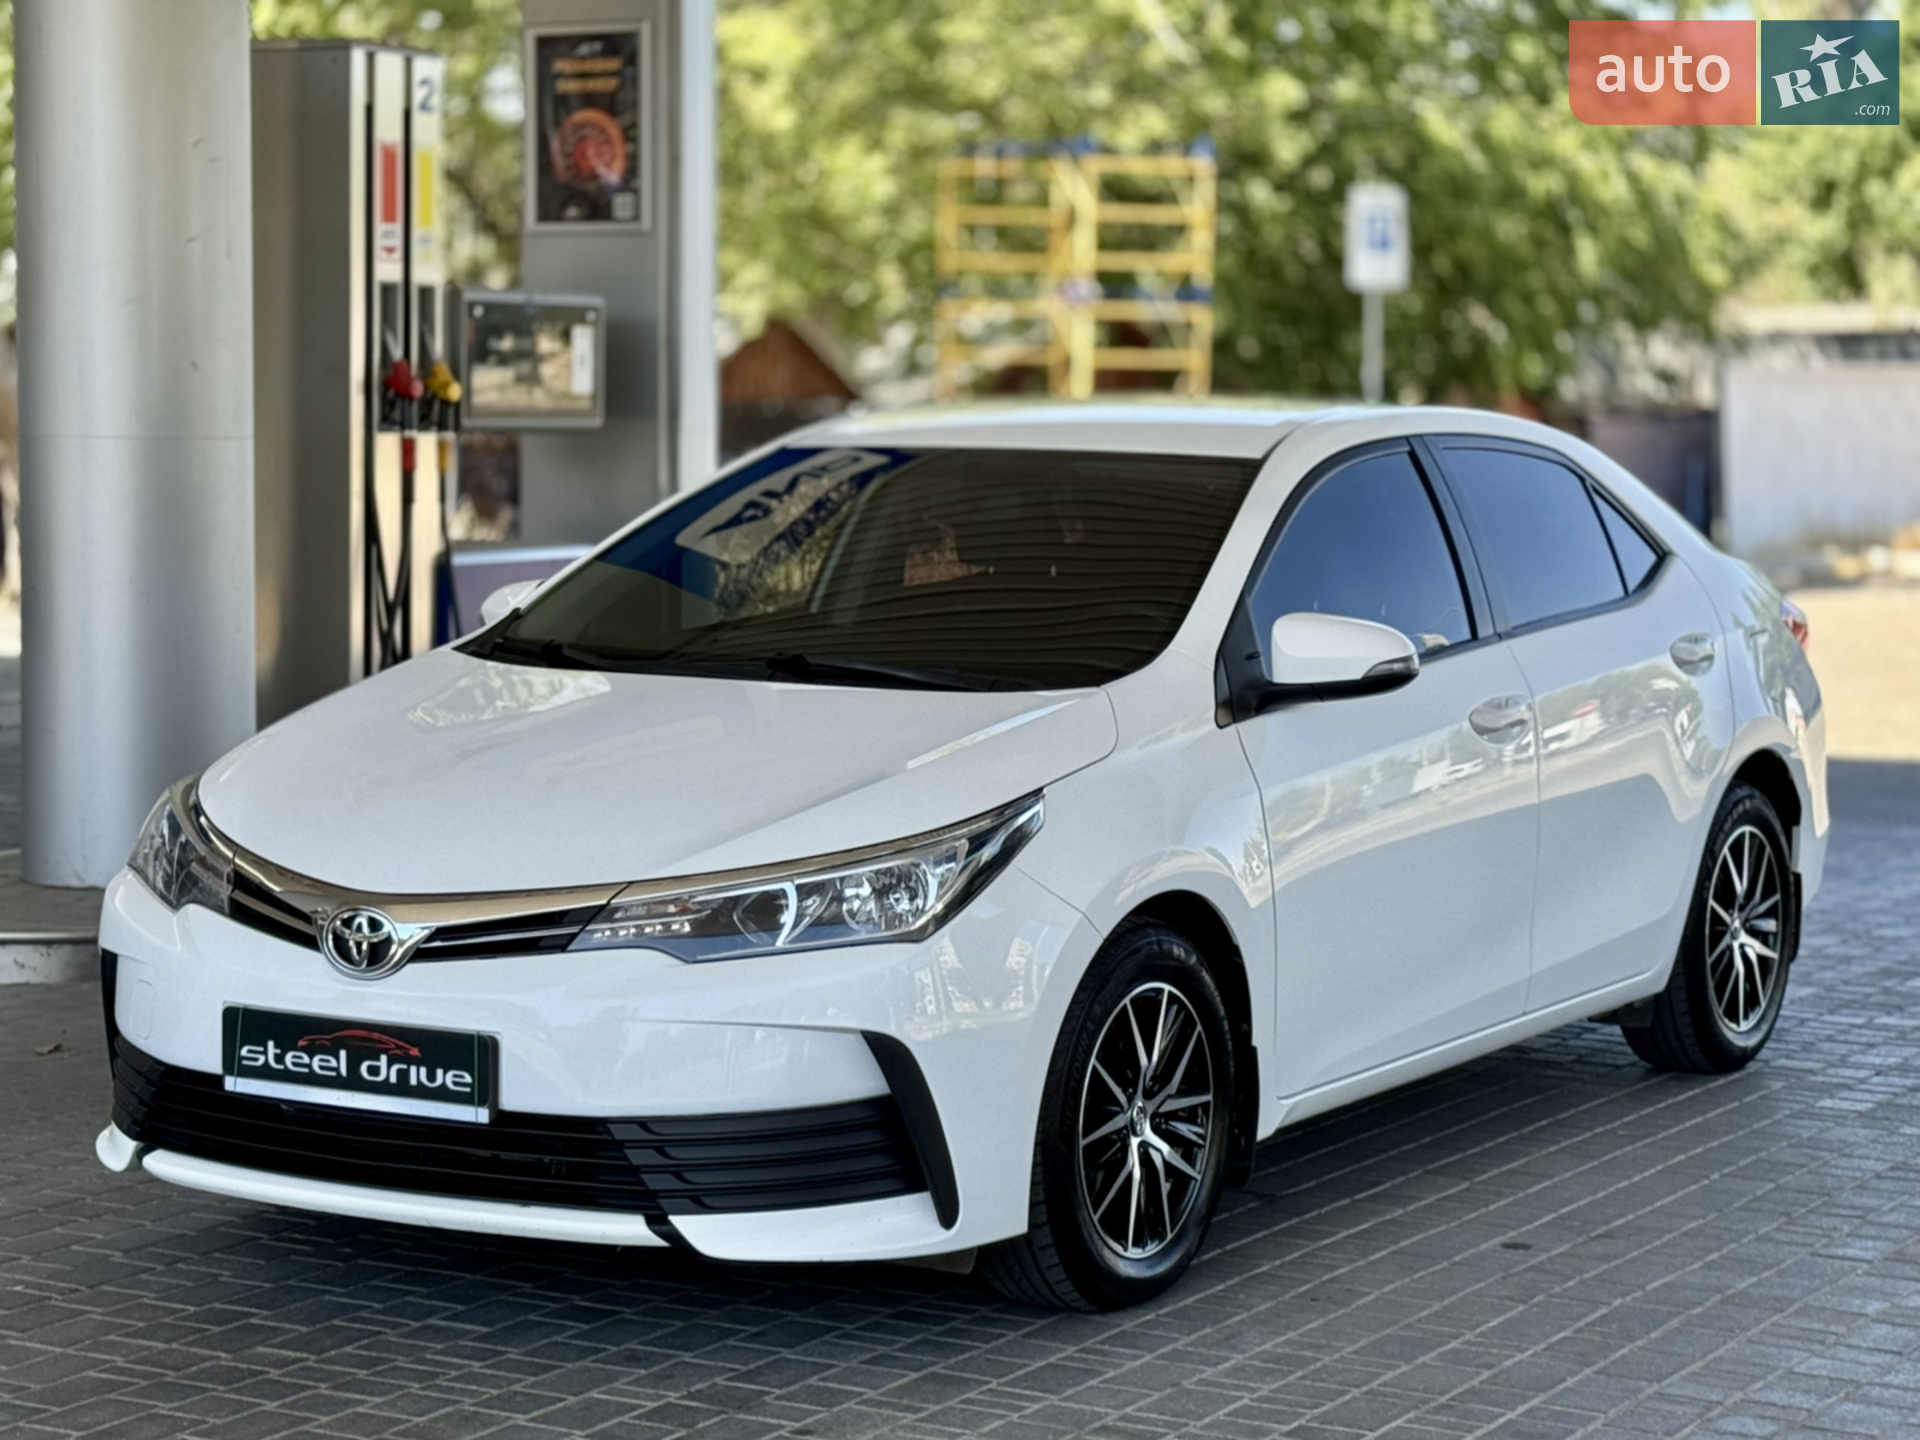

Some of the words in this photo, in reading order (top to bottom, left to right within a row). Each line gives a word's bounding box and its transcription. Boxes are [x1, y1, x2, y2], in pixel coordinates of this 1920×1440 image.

[418, 77, 435, 113] 2
[240, 1040, 347, 1077] steel
[360, 1053, 473, 1092] drive
